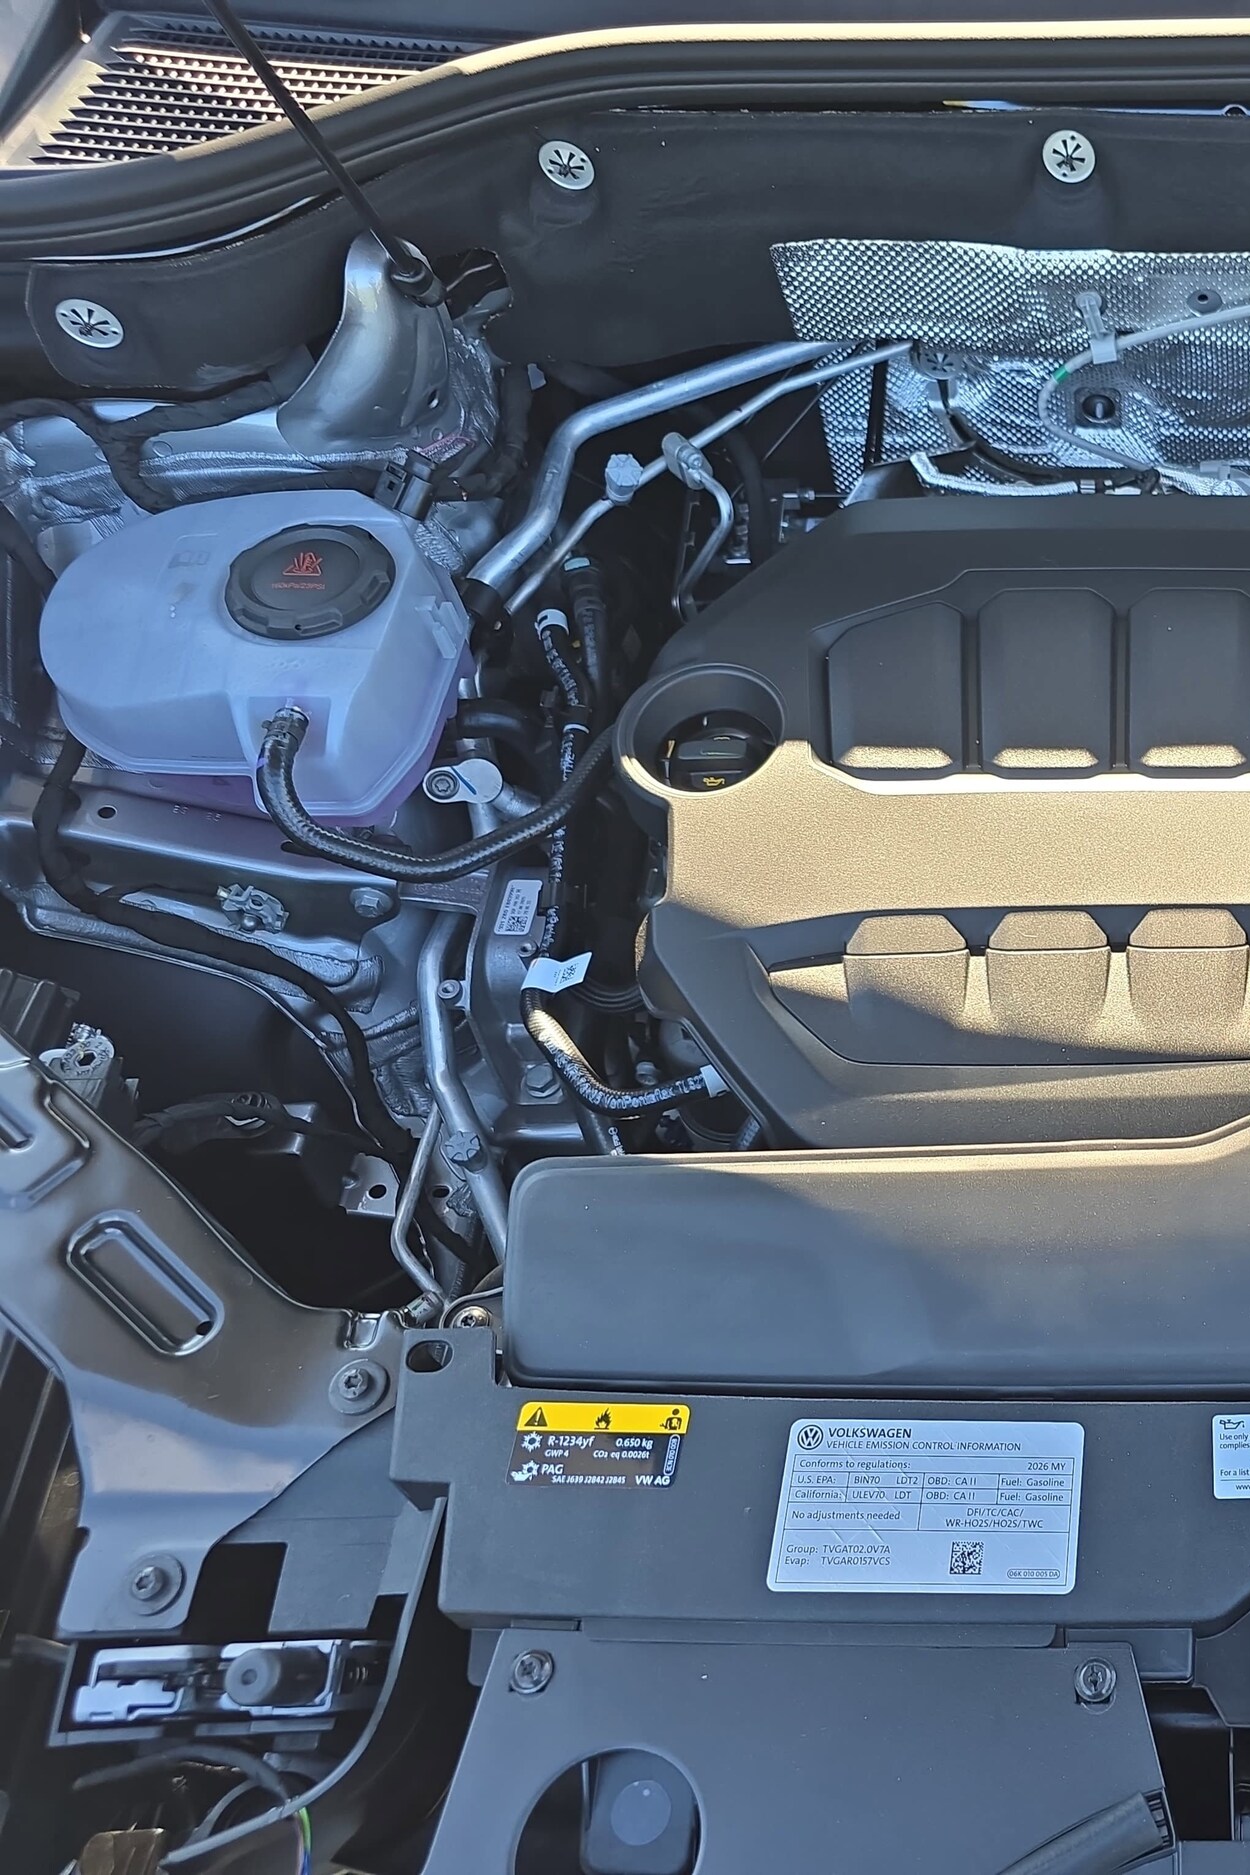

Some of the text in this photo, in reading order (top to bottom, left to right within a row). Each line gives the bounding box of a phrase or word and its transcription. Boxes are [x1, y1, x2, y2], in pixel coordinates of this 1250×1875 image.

[828, 1427, 912, 1438] VOLKSWAGEN
[1234, 1433, 1248, 1441] only
[548, 1435, 653, 1450] R-1234yf 0.650 kg
[826, 1441, 1021, 1451] VEHICLE EMISSION CONTROL INFORMATION
[1220, 1441, 1250, 1450] complies
[544, 1449, 569, 1458] GWP 4
[610, 1450, 650, 1460] eq 0.0026t
[800, 1459, 911, 1470] Conforms to regulations:
[1027, 1462, 1066, 1471] 2026 MY
[541, 1464, 564, 1475] PAG
[1238, 1468, 1250, 1476] list
[552, 1475, 566, 1484] SAE
[635, 1475, 671, 1485] VW AG
[797, 1476, 836, 1484] U.S. EPA:
[854, 1476, 918, 1485] BIN70 LDT2
[927, 1476, 968, 1485] OBD: CA
[1001, 1478, 1065, 1487] Fuel: Gasoline
[795, 1490, 842, 1499] California:
[852, 1490, 912, 1499] ULEV70 LDT
[926, 1491, 966, 1500] OBD: CA
[1000, 1492, 1064, 1502] Fuel: Gasoline
[792, 1510, 900, 1522] No adjustments needed
[967, 1508, 1024, 1517] DFI/TC/CAC/
[945, 1518, 1044, 1528] WR-HO2S/HO2S/TWC
[786, 1544, 891, 1555] Group: TVGAT02.0V7A
[785, 1556, 891, 1567] Evap: TVGAR0157VCS
